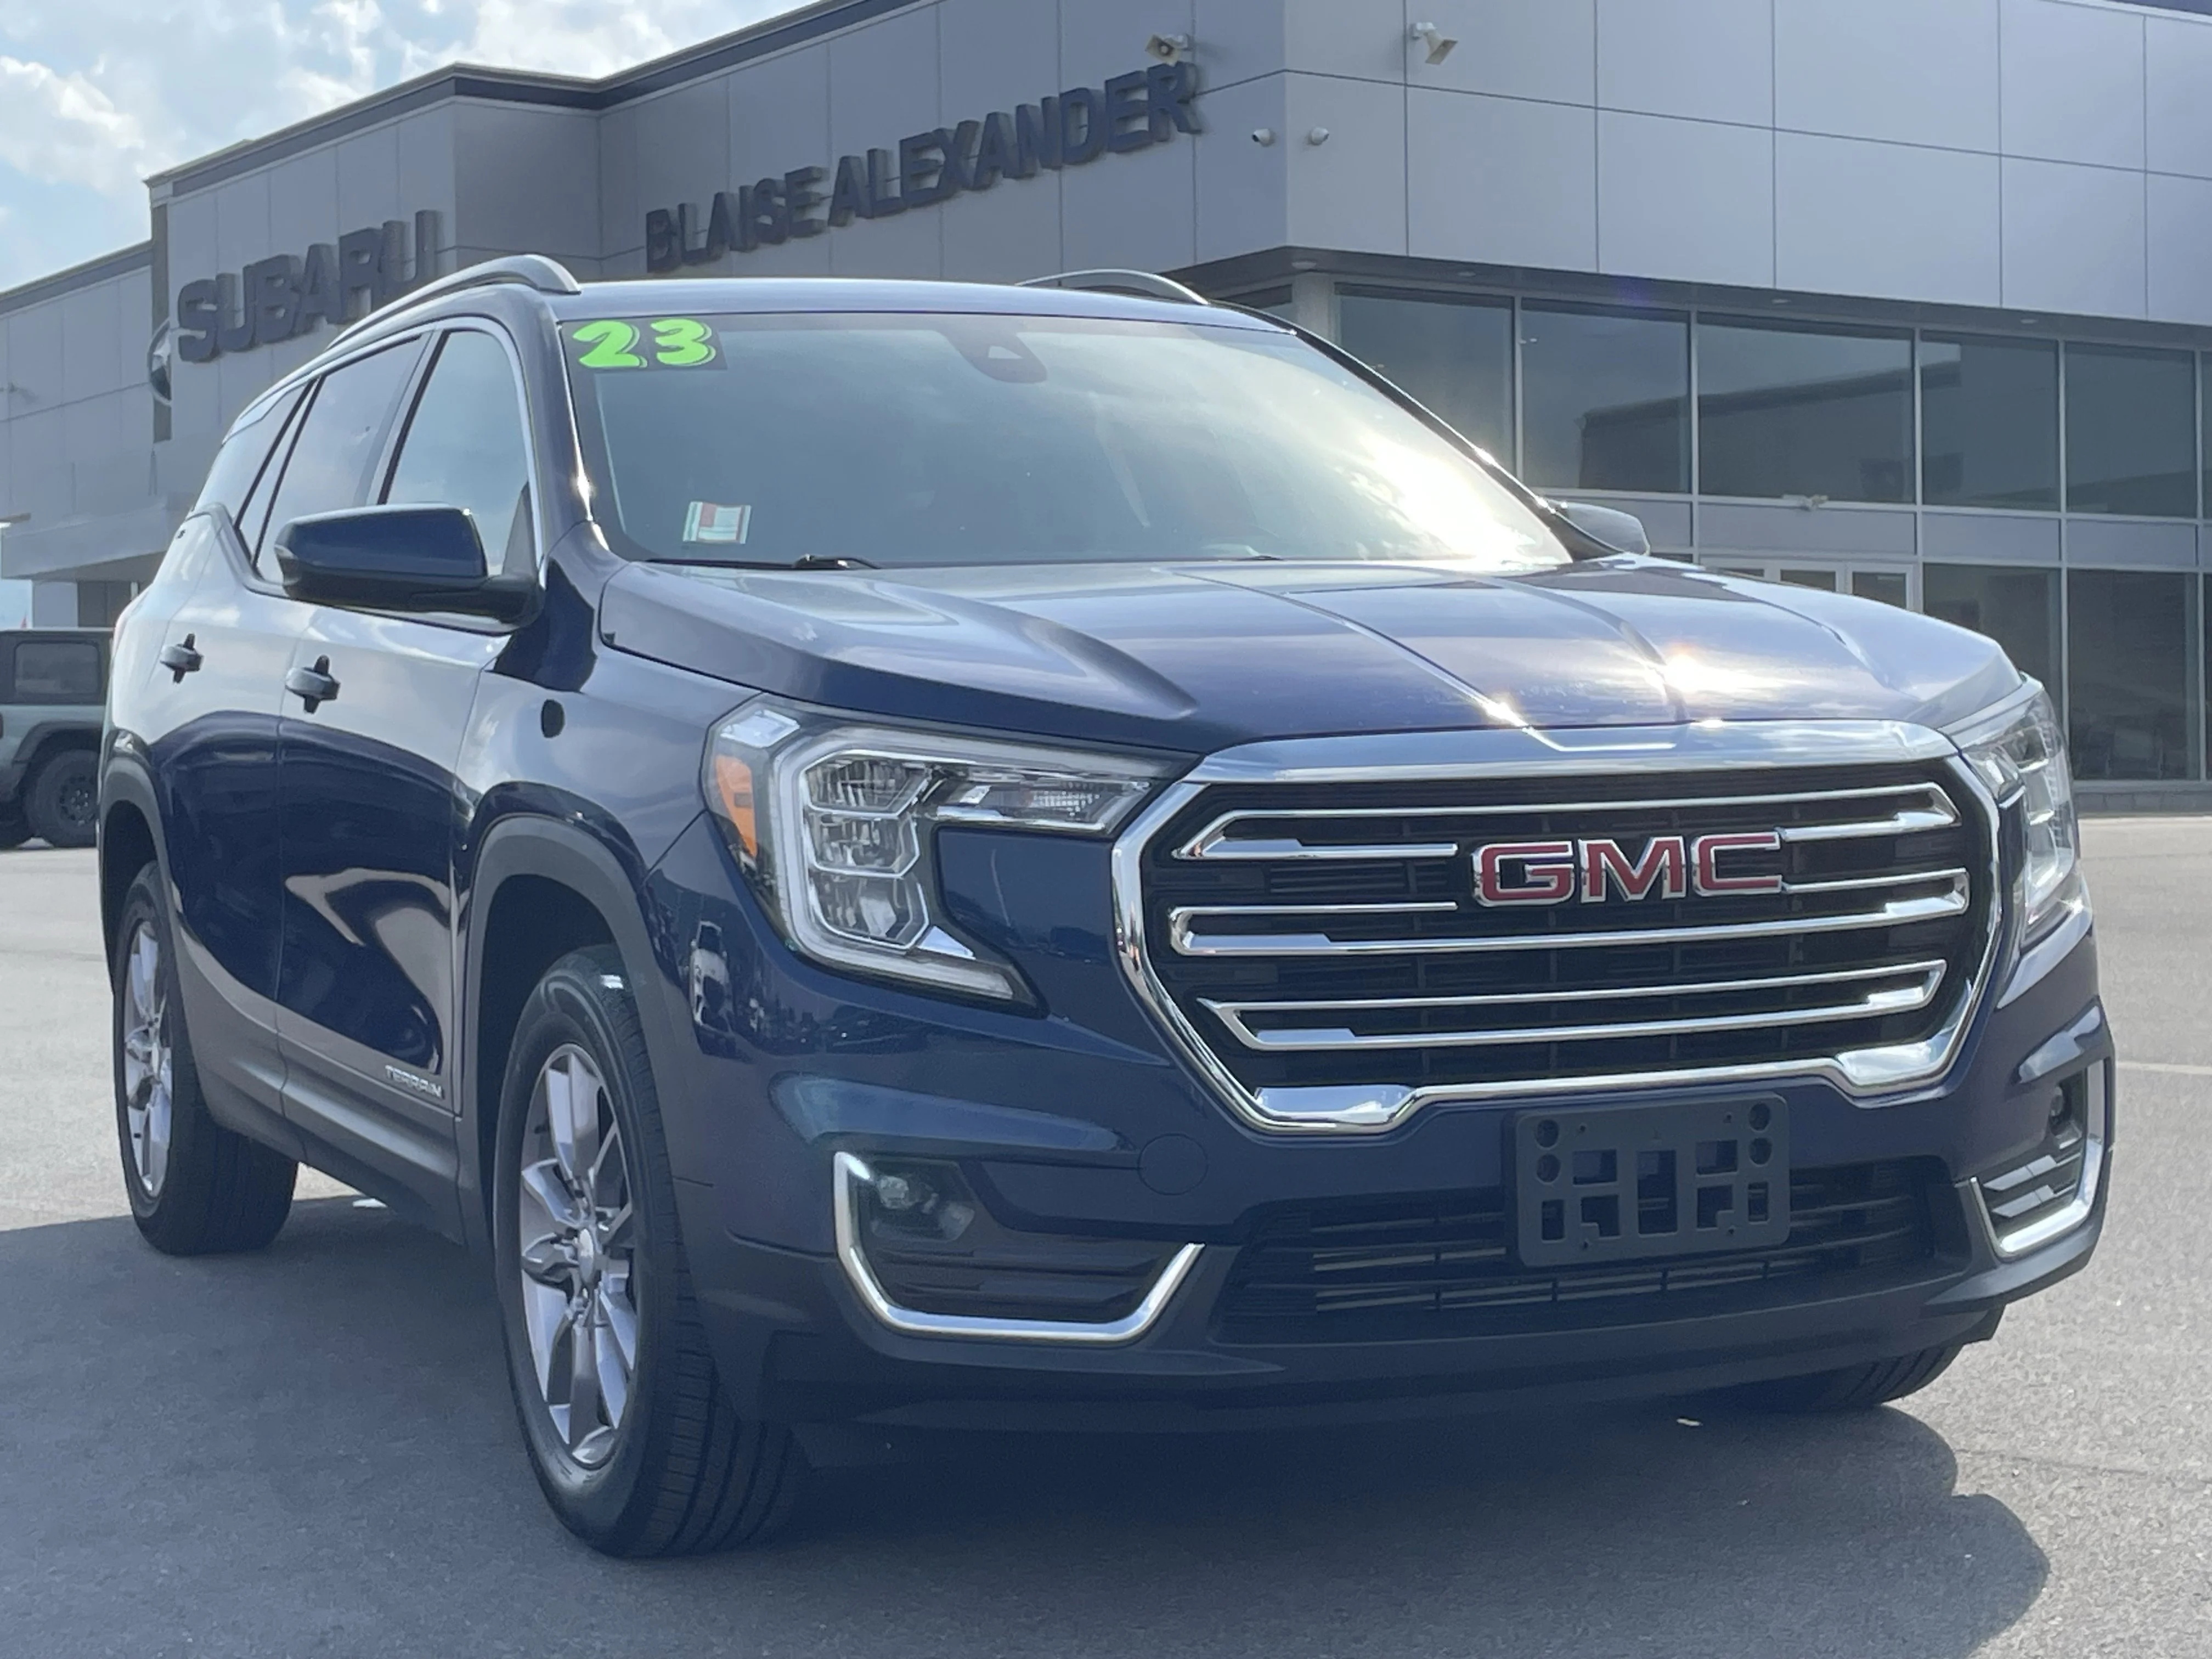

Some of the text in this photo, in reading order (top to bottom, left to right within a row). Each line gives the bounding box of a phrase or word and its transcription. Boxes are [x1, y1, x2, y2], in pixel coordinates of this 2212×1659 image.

[646, 61, 1202, 274] BLAISE ALEXANDER
[177, 210, 442, 363] SUBARU
[572, 318, 716, 368] 23
[1471, 831, 1782, 907] GMC
